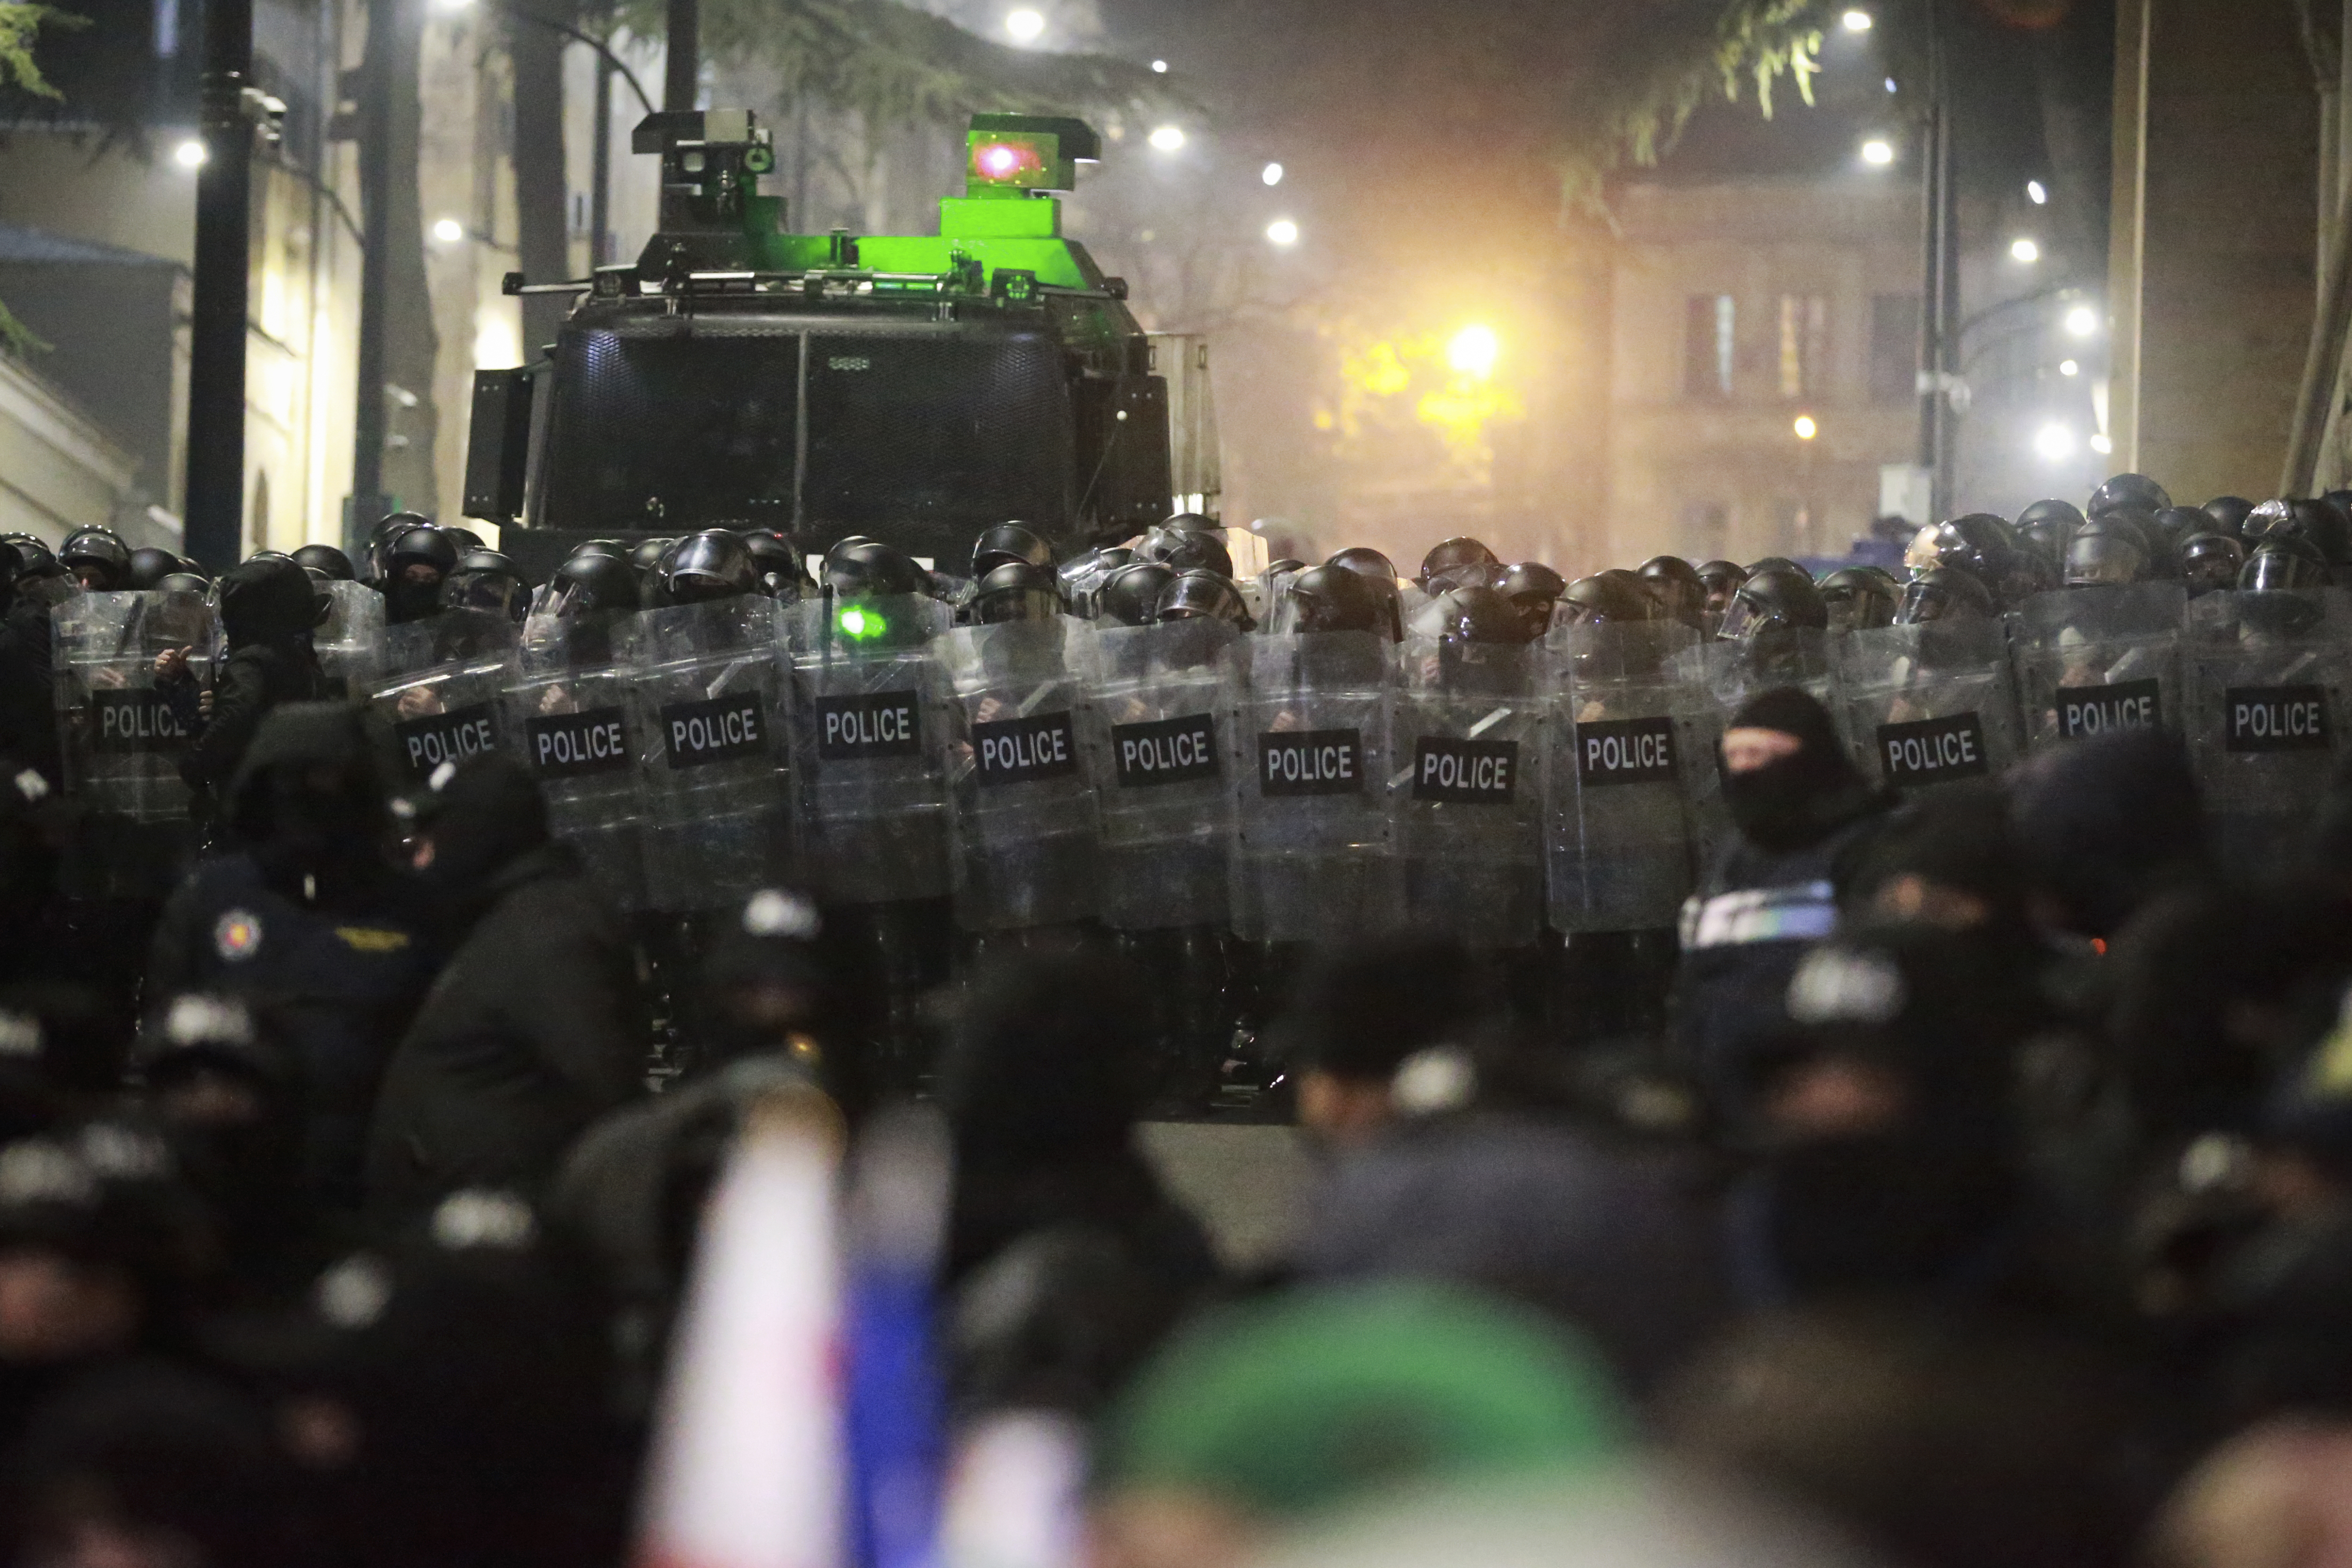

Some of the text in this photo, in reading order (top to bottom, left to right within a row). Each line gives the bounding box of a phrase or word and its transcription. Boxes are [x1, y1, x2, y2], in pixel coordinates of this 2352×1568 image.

[673, 709, 757, 751] POLICE
[826, 707, 911, 744] POLICE
[2067, 696, 2153, 736] POLICE
[2236, 702, 2320, 736] POLICE
[408, 719, 494, 767] POLICE
[538, 723, 624, 765] POLICE
[982, 729, 1066, 770] POLICE
[1124, 732, 1209, 772] POLICE
[1587, 733, 1668, 770] POLICE
[1888, 730, 1976, 771] POLICE
[1268, 746, 1352, 781] POLICE
[1423, 753, 1507, 789] POLICE
